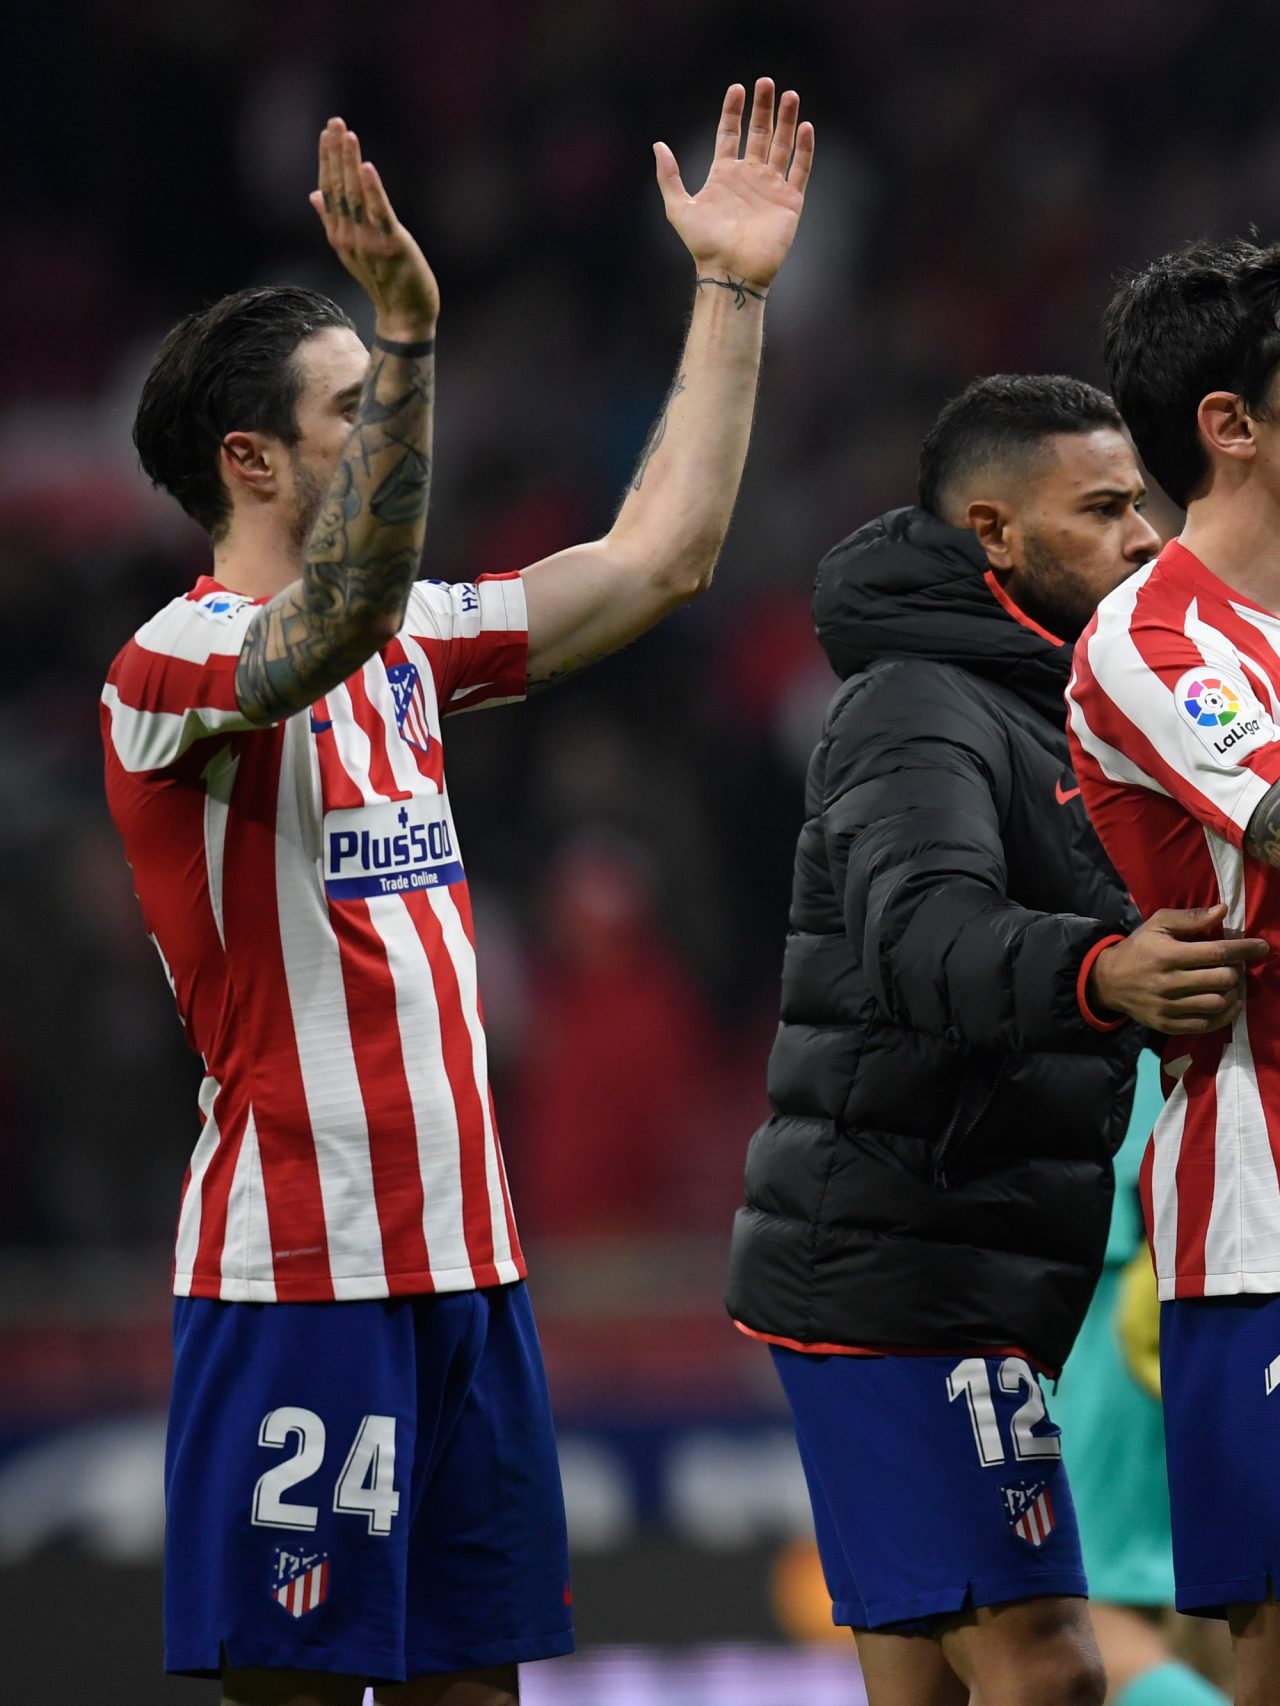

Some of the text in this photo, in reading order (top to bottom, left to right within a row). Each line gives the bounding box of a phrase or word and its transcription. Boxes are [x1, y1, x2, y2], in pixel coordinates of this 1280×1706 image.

[462, 583, 479, 612] HY
[1213, 719, 1261, 754] LaLiga
[379, 871, 439, 892] Trade Online
[945, 1357, 1061, 1467] 12
[251, 1406, 399, 1536] 24
